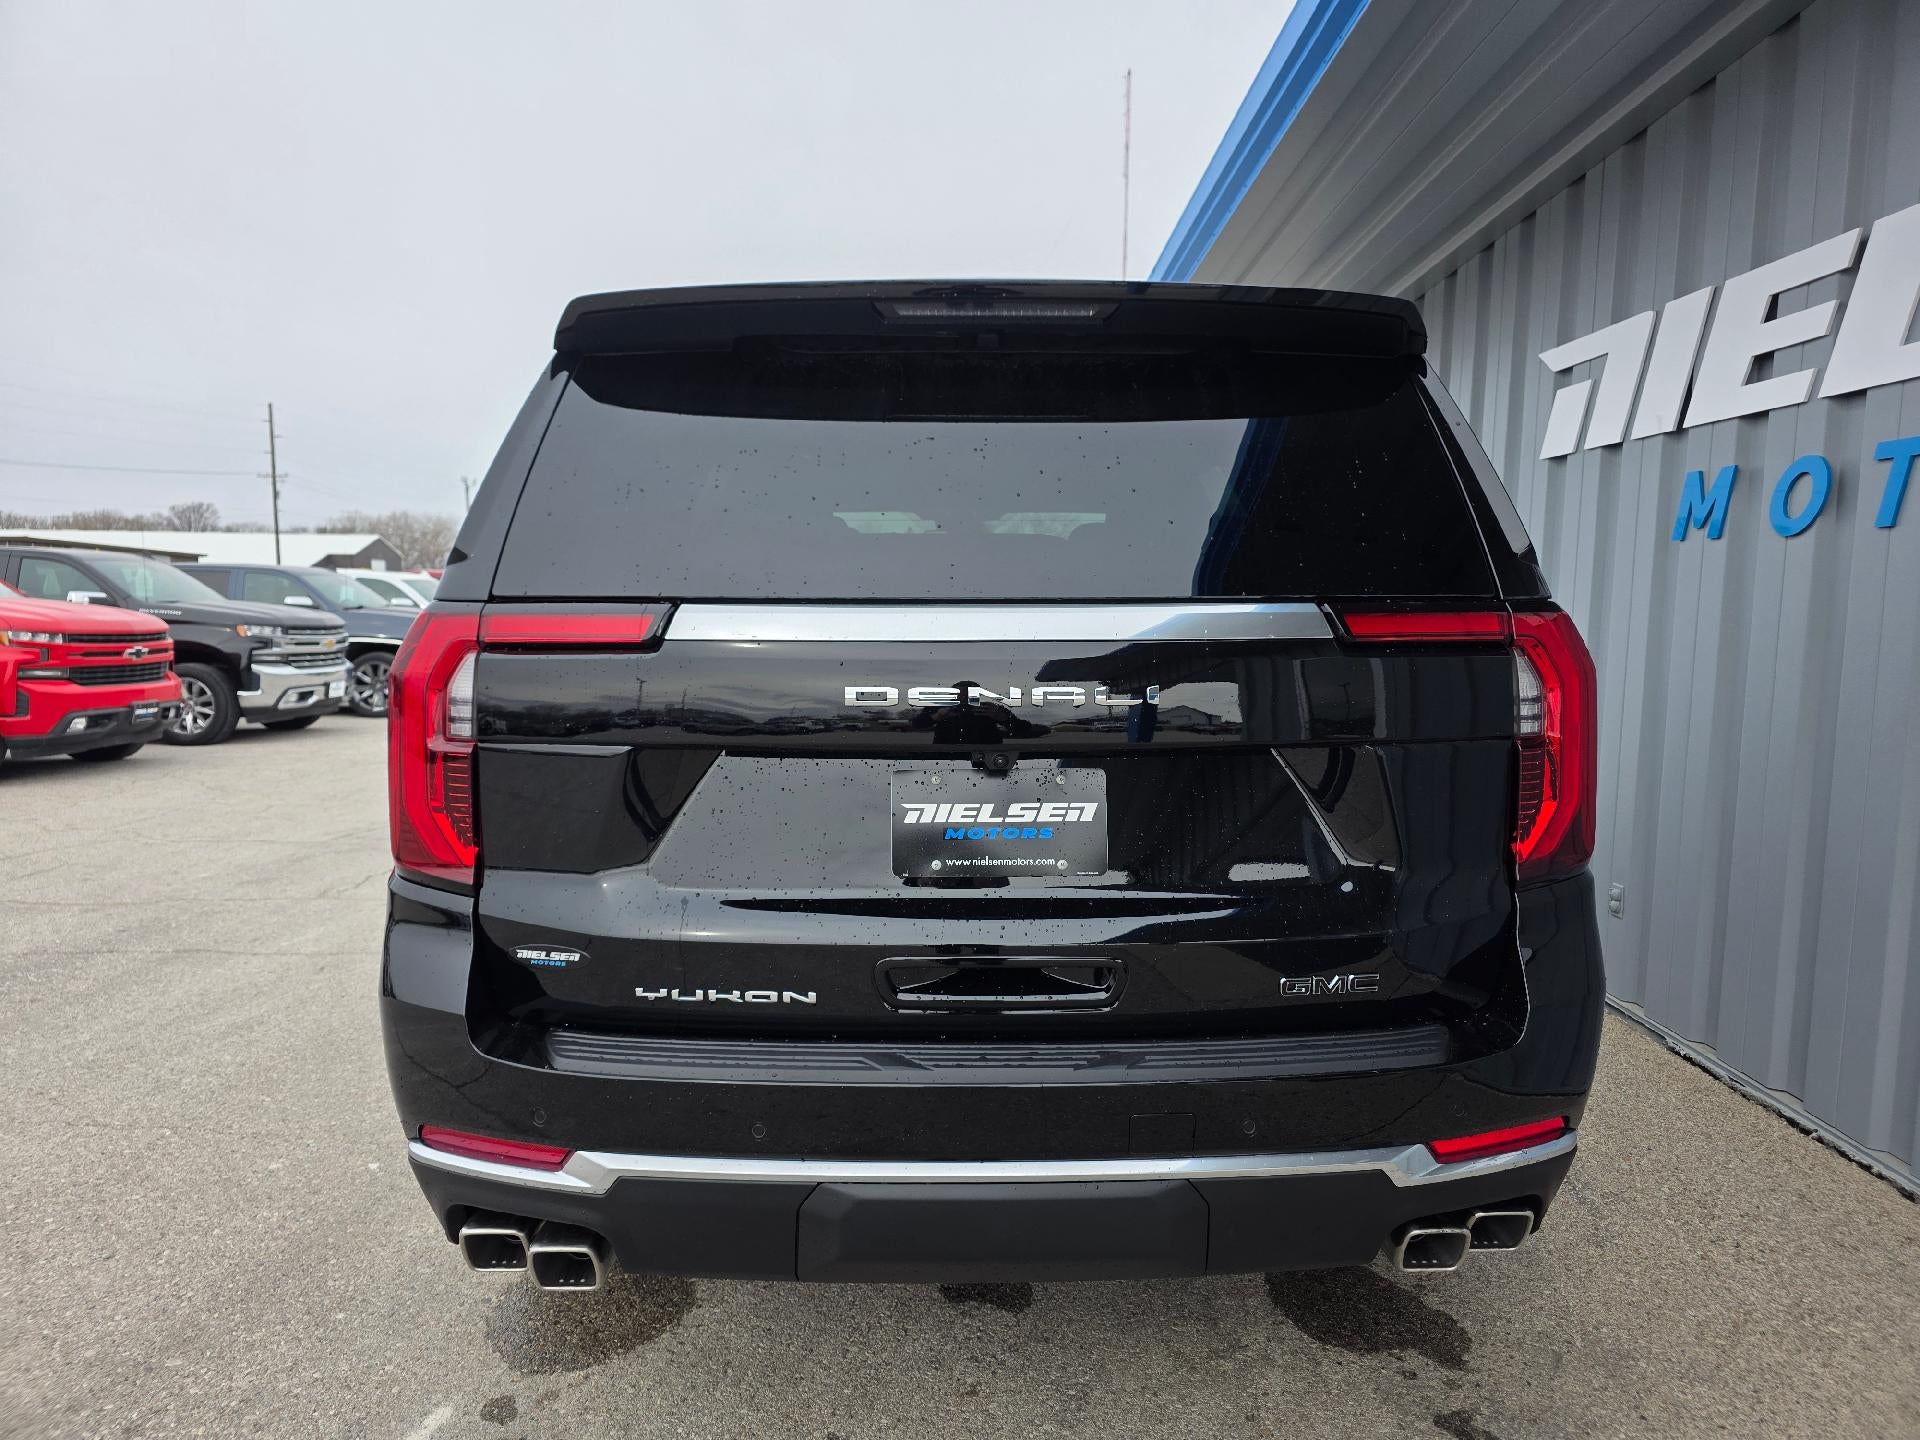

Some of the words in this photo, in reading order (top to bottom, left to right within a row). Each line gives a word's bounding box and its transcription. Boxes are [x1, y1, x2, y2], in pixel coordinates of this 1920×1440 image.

[845, 685, 1160, 707] DENALI
[901, 803, 1099, 824] NIELSEN
[945, 827, 1054, 840] MOTORS
[946, 856, 1056, 867] wwwnielsenmotors.com
[516, 949, 581, 962] NIELSEN
[530, 959, 566, 967] MOTORS
[1279, 974, 1380, 997] GMC
[635, 987, 817, 1004] YUKON
